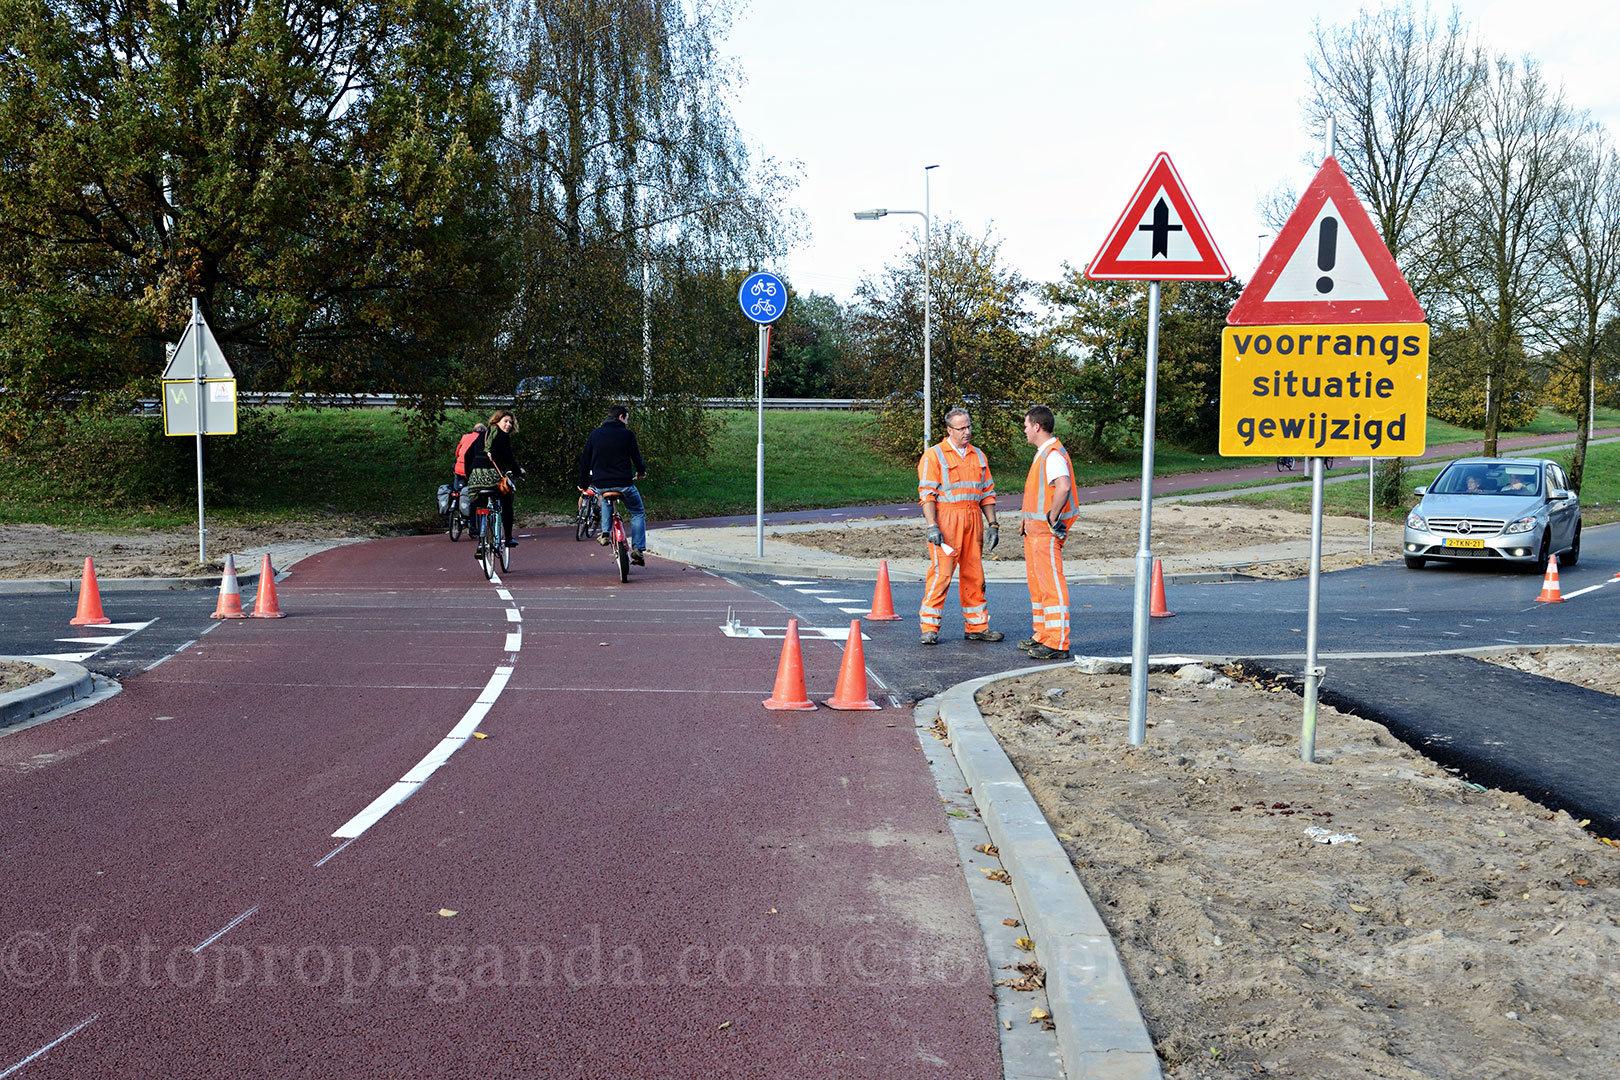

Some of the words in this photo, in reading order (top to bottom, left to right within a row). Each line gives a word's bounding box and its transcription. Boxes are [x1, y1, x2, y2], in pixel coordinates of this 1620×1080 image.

[1233, 334, 1420, 365] voorrangs
[1252, 370, 1394, 398] situatie
[1237, 412, 1406, 449] gewijzigd
[1448, 539, 1481, 547] 2-TKN-21
